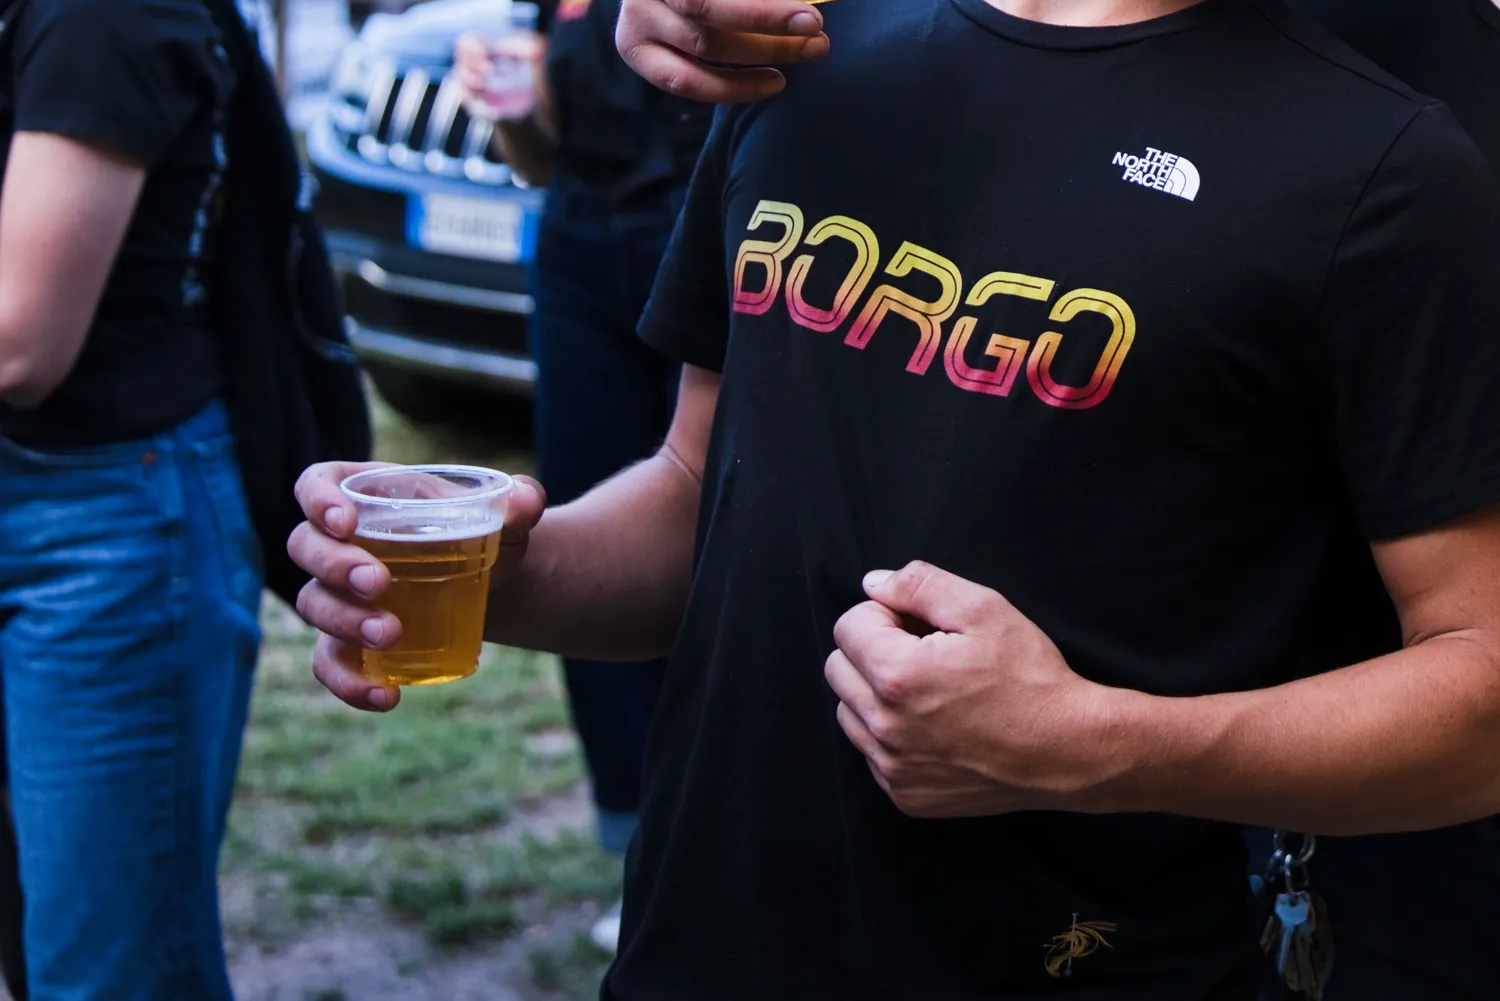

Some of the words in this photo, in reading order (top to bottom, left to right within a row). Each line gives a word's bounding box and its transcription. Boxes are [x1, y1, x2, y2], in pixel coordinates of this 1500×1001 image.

[1112, 151, 1173, 179] NORTH
[1145, 146, 1179, 168] THE
[1122, 167, 1167, 191] FACE
[733, 199, 1136, 410] BORGO
